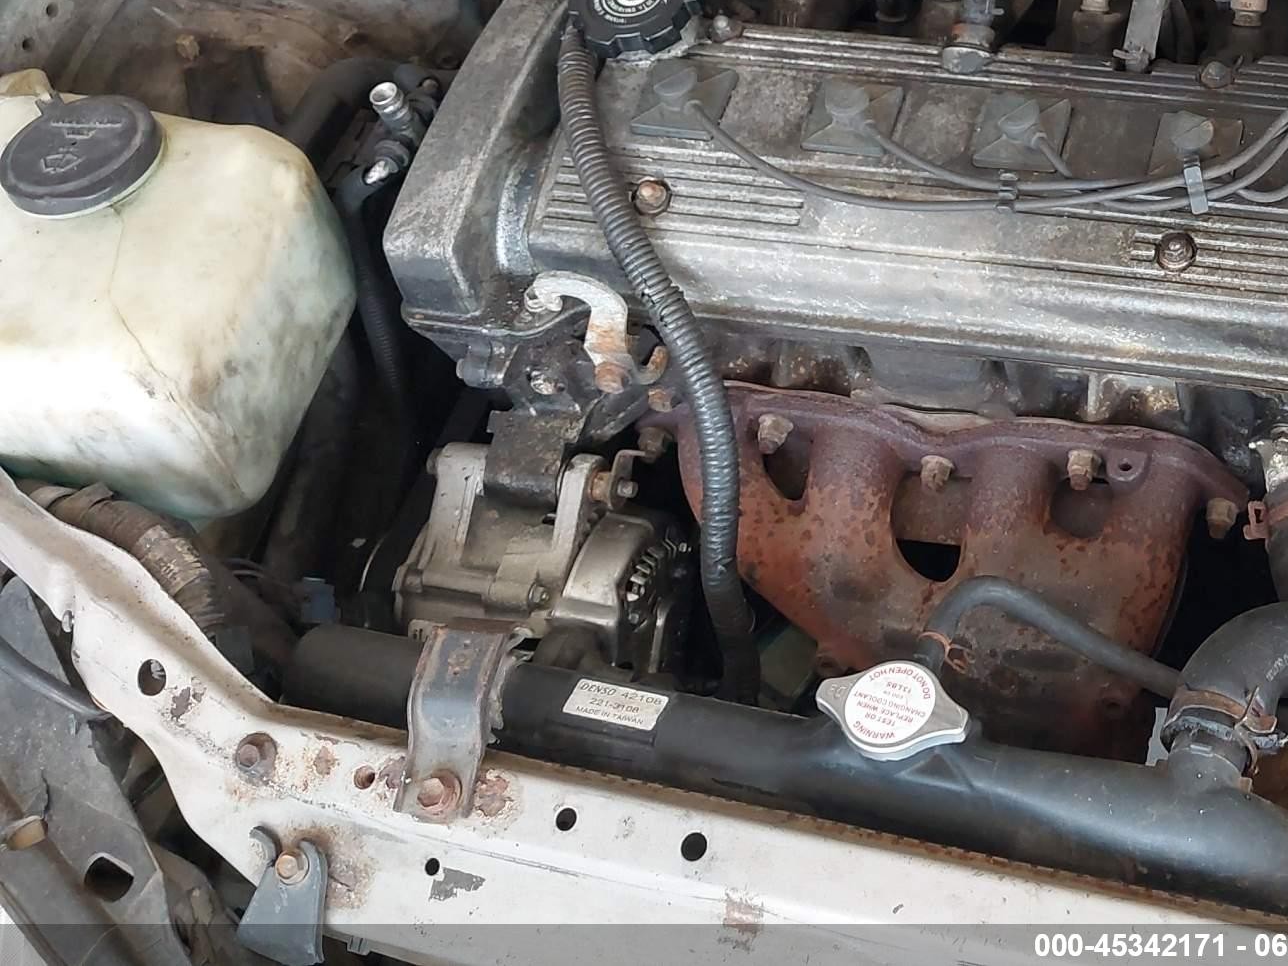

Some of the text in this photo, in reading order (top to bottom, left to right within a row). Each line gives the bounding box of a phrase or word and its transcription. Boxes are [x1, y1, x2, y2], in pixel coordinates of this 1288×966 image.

[888, 666, 913, 676] OPEN
[913, 672, 926, 687] NOT
[579, 682, 617, 696] DENSO
[923, 687, 931, 700] DO
[854, 691, 887, 706] COOLANT
[575, 705, 600, 715] MADE
[611, 713, 644, 724] TAIWAN
[856, 701, 913, 723] REPLACE WHEN
[888, 700, 926, 717] CHANGING
[864, 712, 896, 727] TEST OR
[853, 720, 895, 740] WARNING
